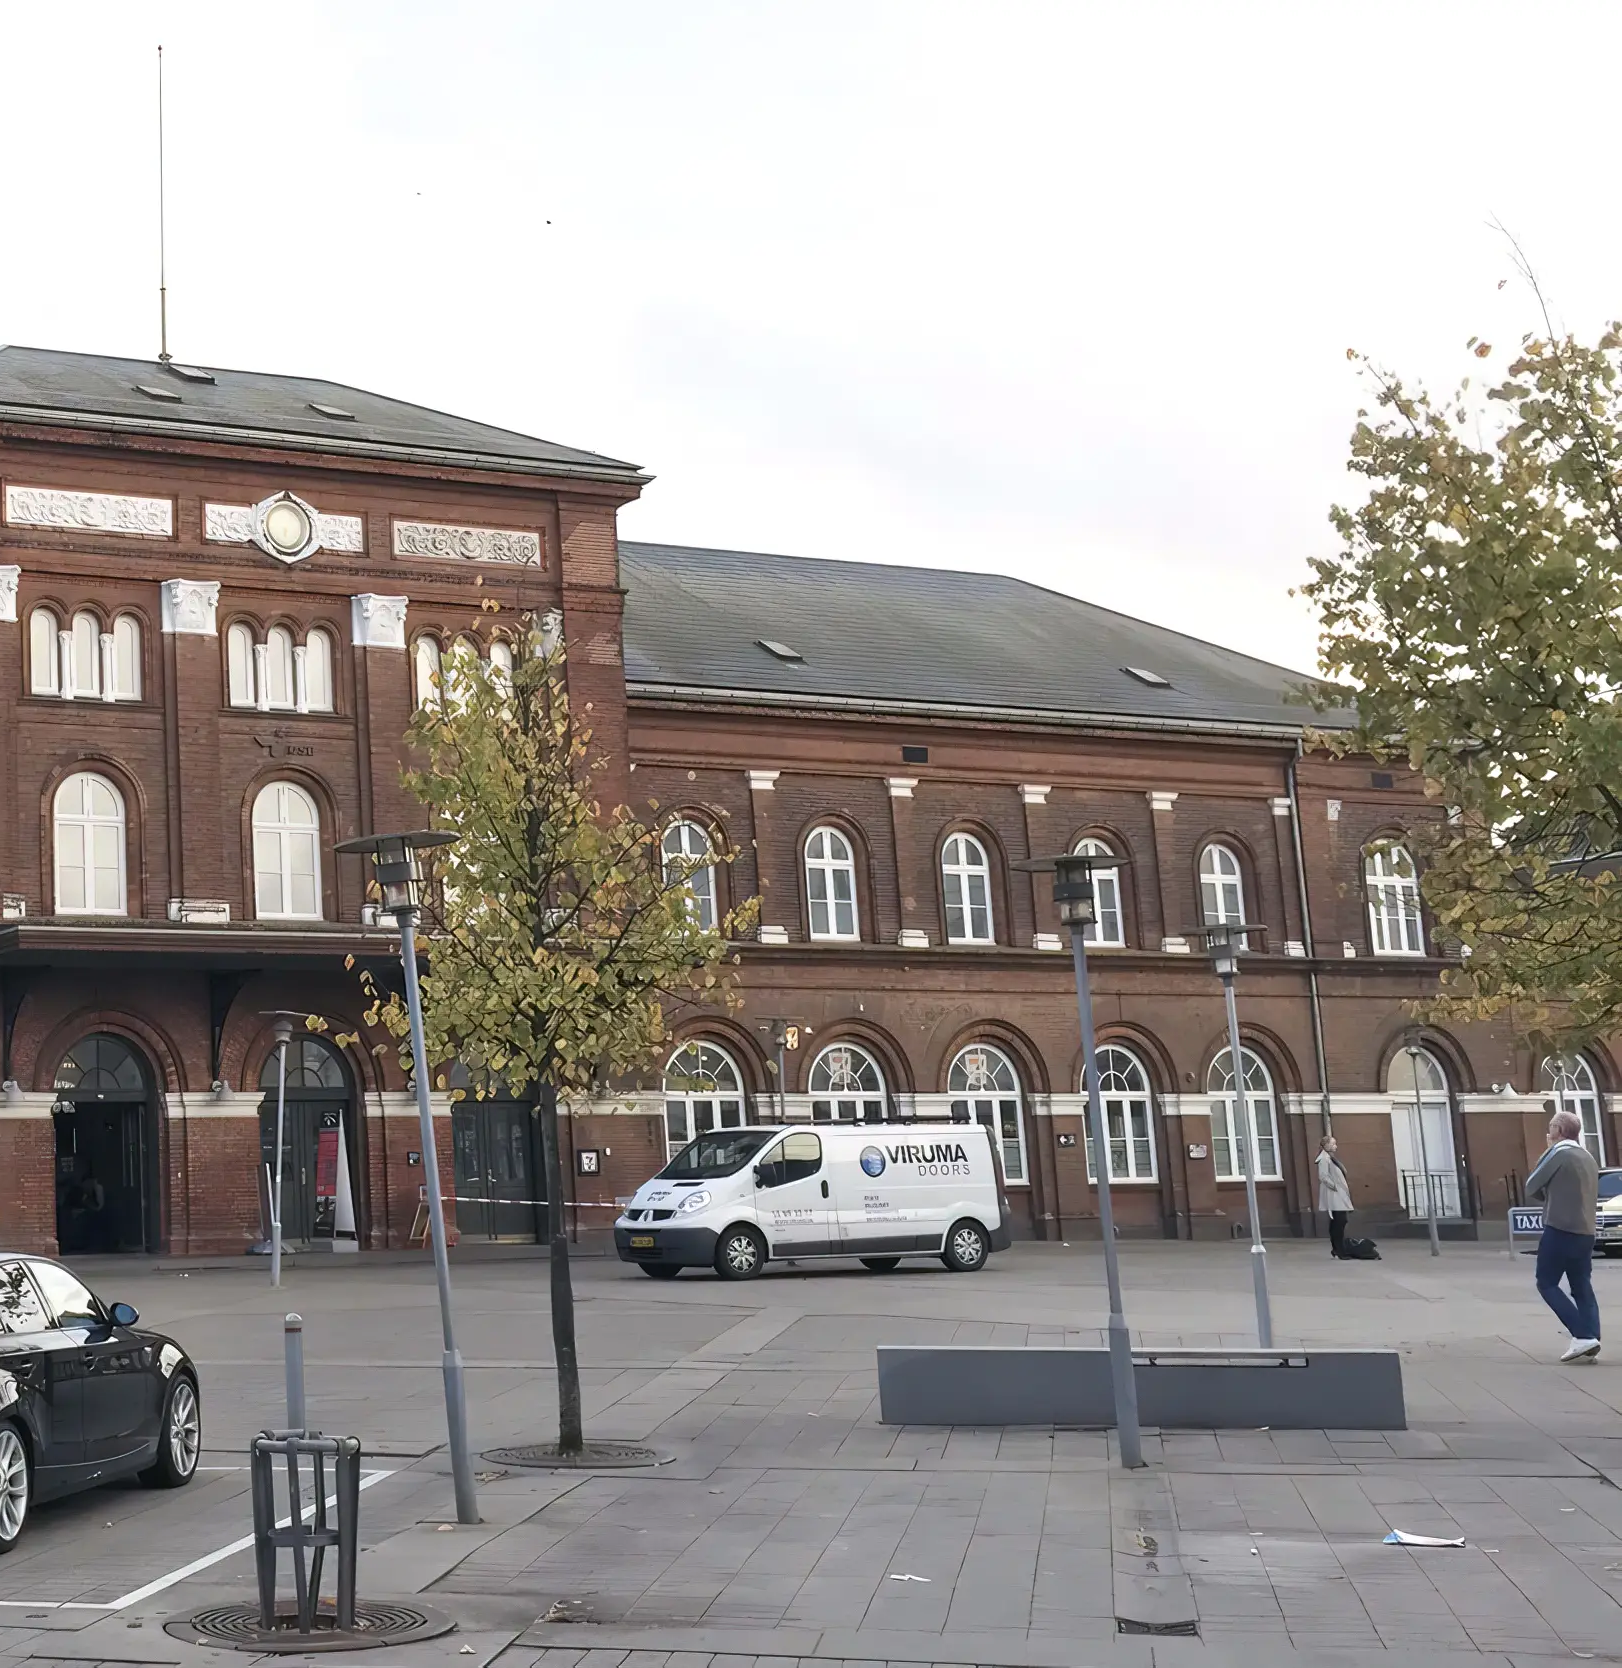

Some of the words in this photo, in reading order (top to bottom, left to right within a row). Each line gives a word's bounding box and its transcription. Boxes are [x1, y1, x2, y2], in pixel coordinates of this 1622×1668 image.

[885, 1144, 968, 1164] VIRUMA
[918, 1164, 970, 1176] DOORS
[1515, 1215, 1544, 1229] TAXI
